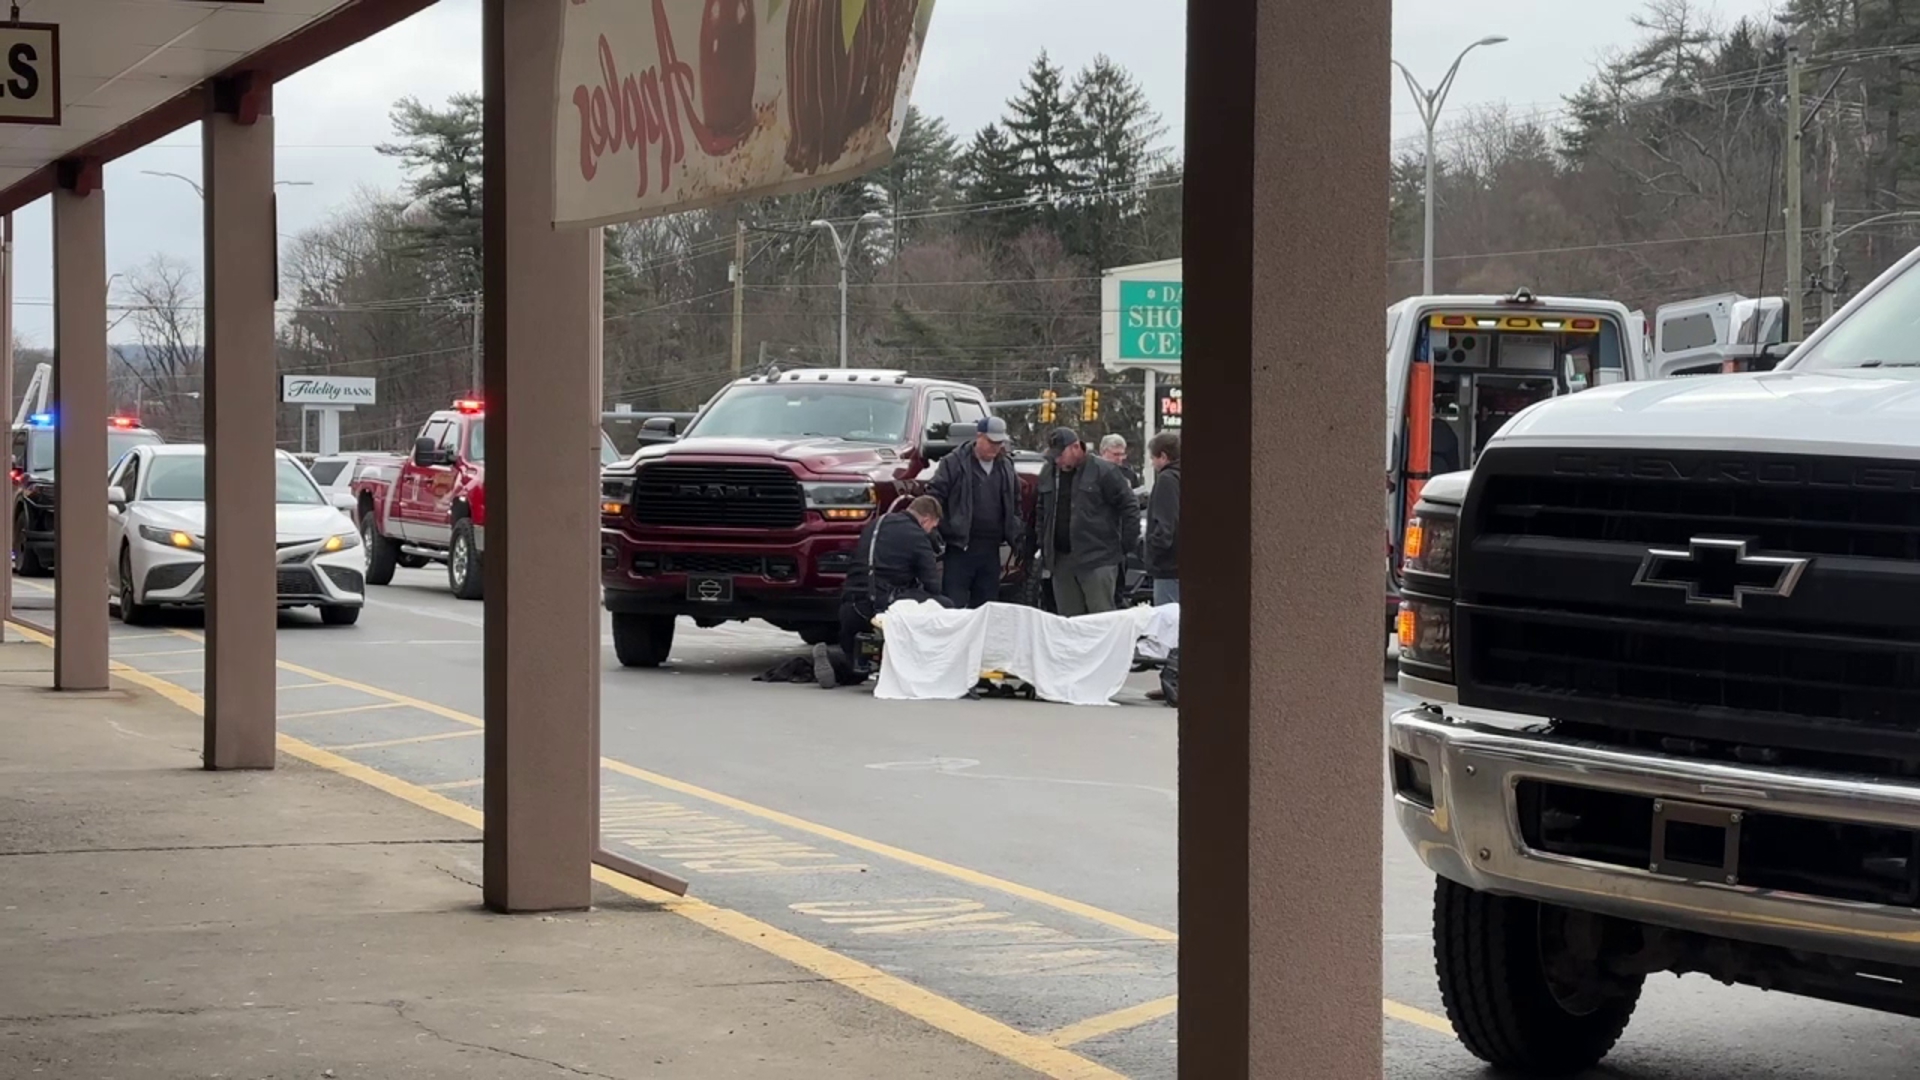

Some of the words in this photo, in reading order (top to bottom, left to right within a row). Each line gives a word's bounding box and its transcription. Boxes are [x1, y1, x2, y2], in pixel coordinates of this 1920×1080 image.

[0, 43, 39, 99] S
[1129, 305, 1182, 328] SHO
[1138, 332, 1182, 354] CE
[288, 380, 341, 400] Fidelity
[343, 387, 372, 397] BANK
[1554, 452, 1920, 491] CHEVROLE
